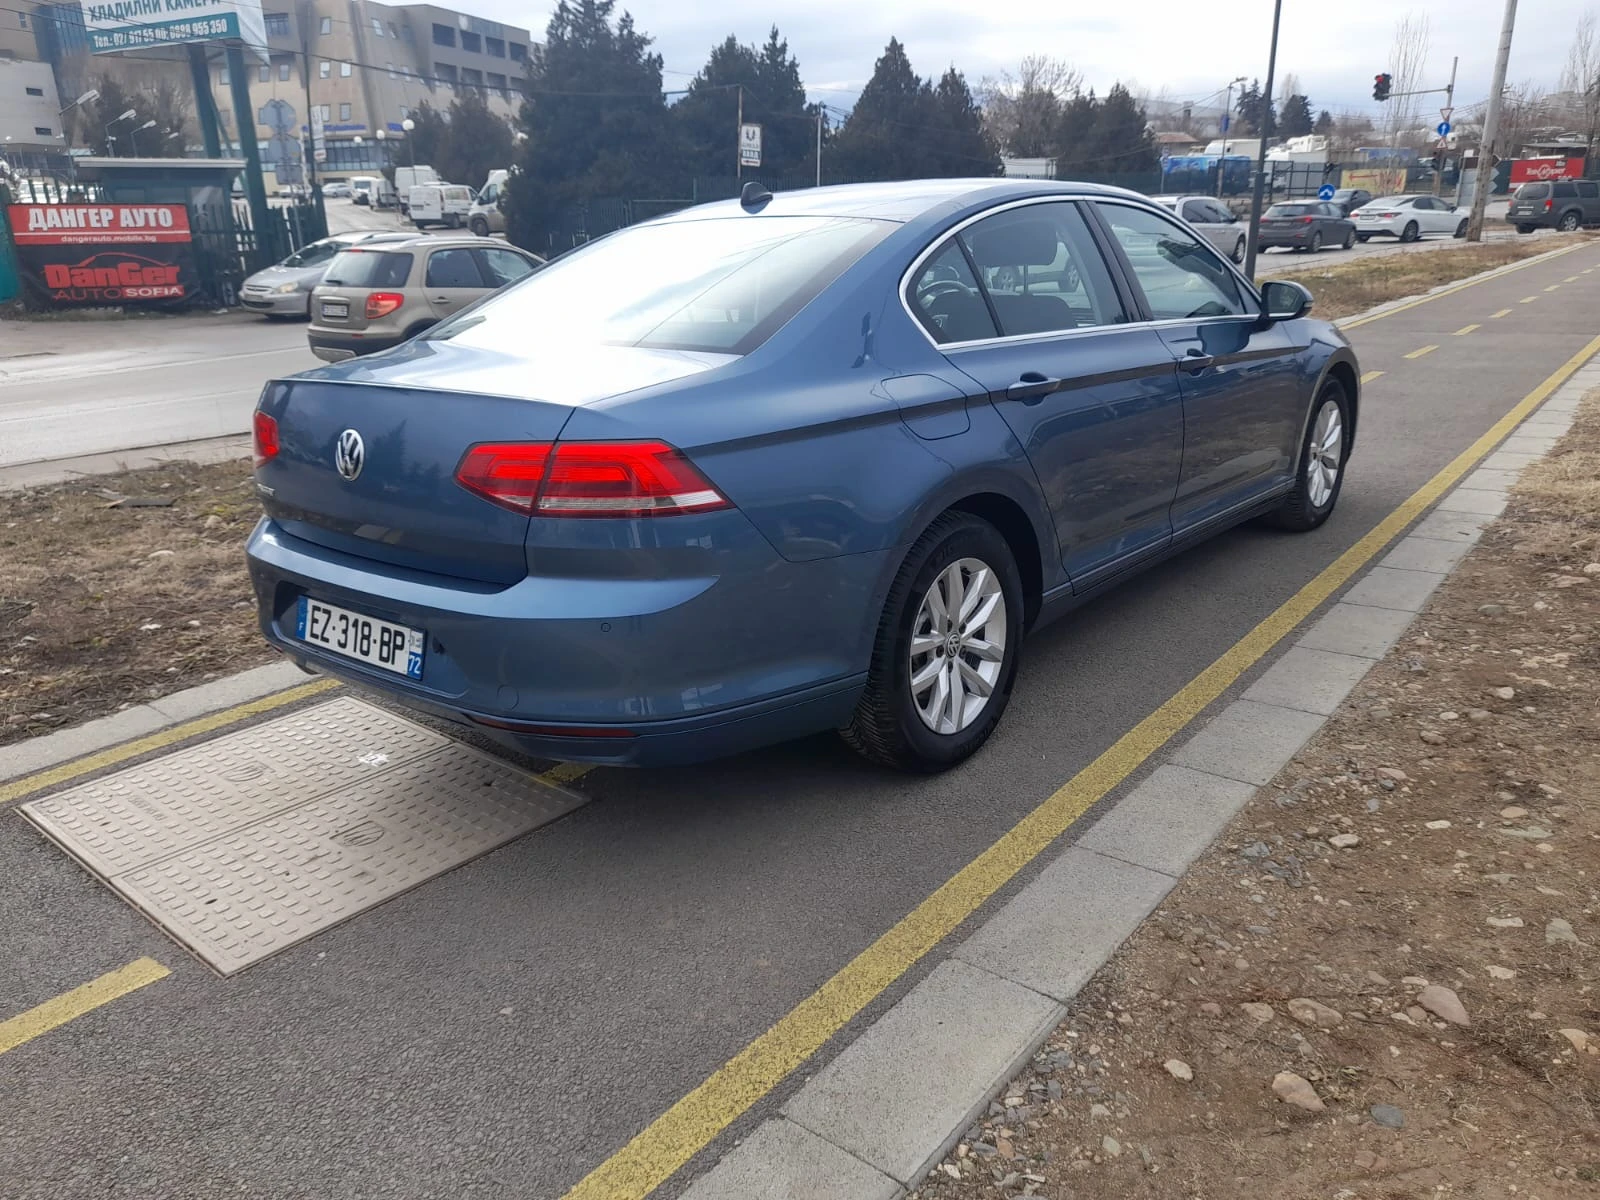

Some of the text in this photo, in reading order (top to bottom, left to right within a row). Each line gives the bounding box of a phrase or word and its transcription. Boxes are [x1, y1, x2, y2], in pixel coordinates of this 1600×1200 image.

[166, 0, 221, 11] КАМ
[210, 19, 227, 33] 350
[28, 208, 173, 231] ДАНГЕР АУТО
[53, 286, 182, 301] AUTO SOFIA
[408, 654, 421, 674] 72
